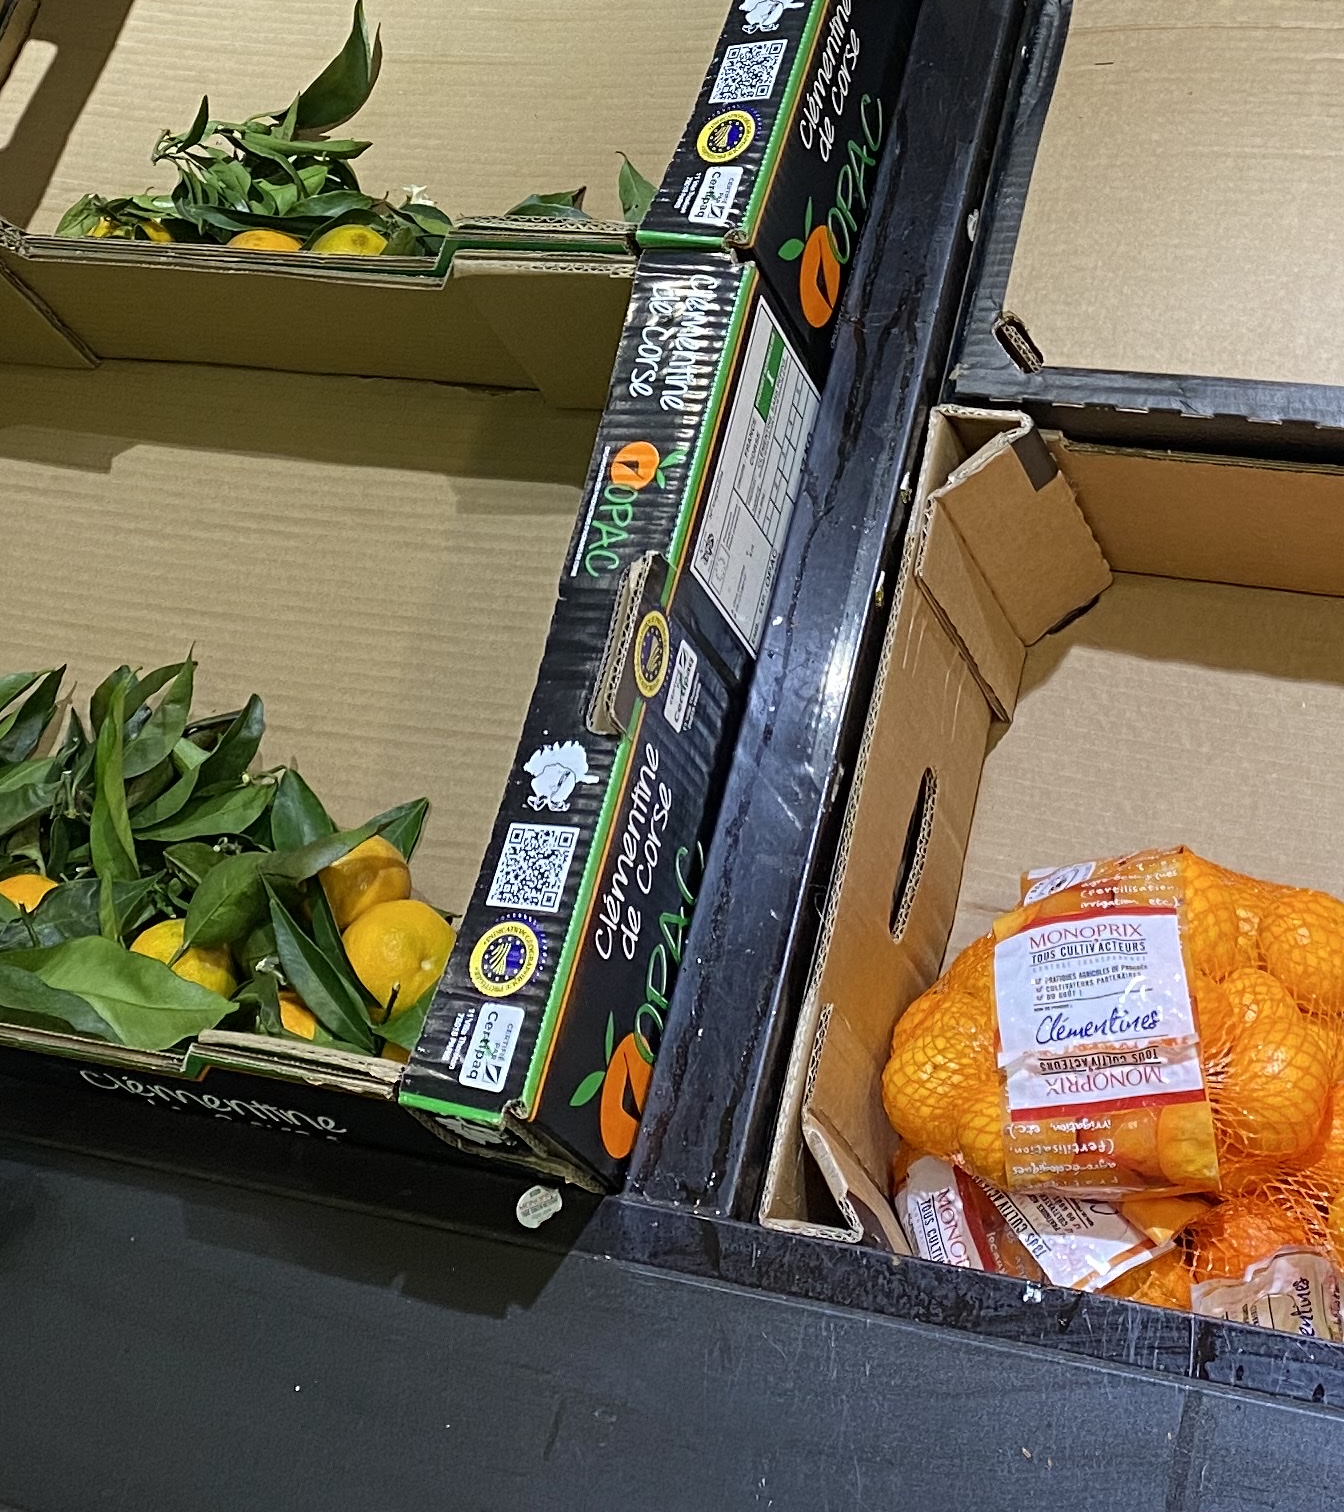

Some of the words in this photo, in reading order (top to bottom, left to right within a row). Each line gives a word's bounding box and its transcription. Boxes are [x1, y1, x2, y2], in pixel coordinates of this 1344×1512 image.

[818, 115, 835, 163] de
[694, 171, 721, 218] Certipaq
[584, 484, 639, 578] OPAC
[595, 742, 660, 961] Clémentine
[622, 912, 643, 961] de
[1029, 923, 1143, 950] MONOPRIX
[1032, 948, 1056, 965] TOUS
[1045, 972, 1077, 985] PRATIQUES
[1078, 967, 1110, 979] AGRICOLES
[1046, 979, 1094, 993] CULTIVATEURS
[1035, 1006, 1161, 1045] Clémentines
[466, 1011, 498, 1079] Certipaq
[1131, 1048, 1159, 1064] TOUS
[1045, 1068, 1166, 1096] MONOPRIX
[78, 1069, 348, 1135] Clémentine
[920, 1199, 934, 1224] TOUS
[1024, 1234, 1047, 1259] TOUS
